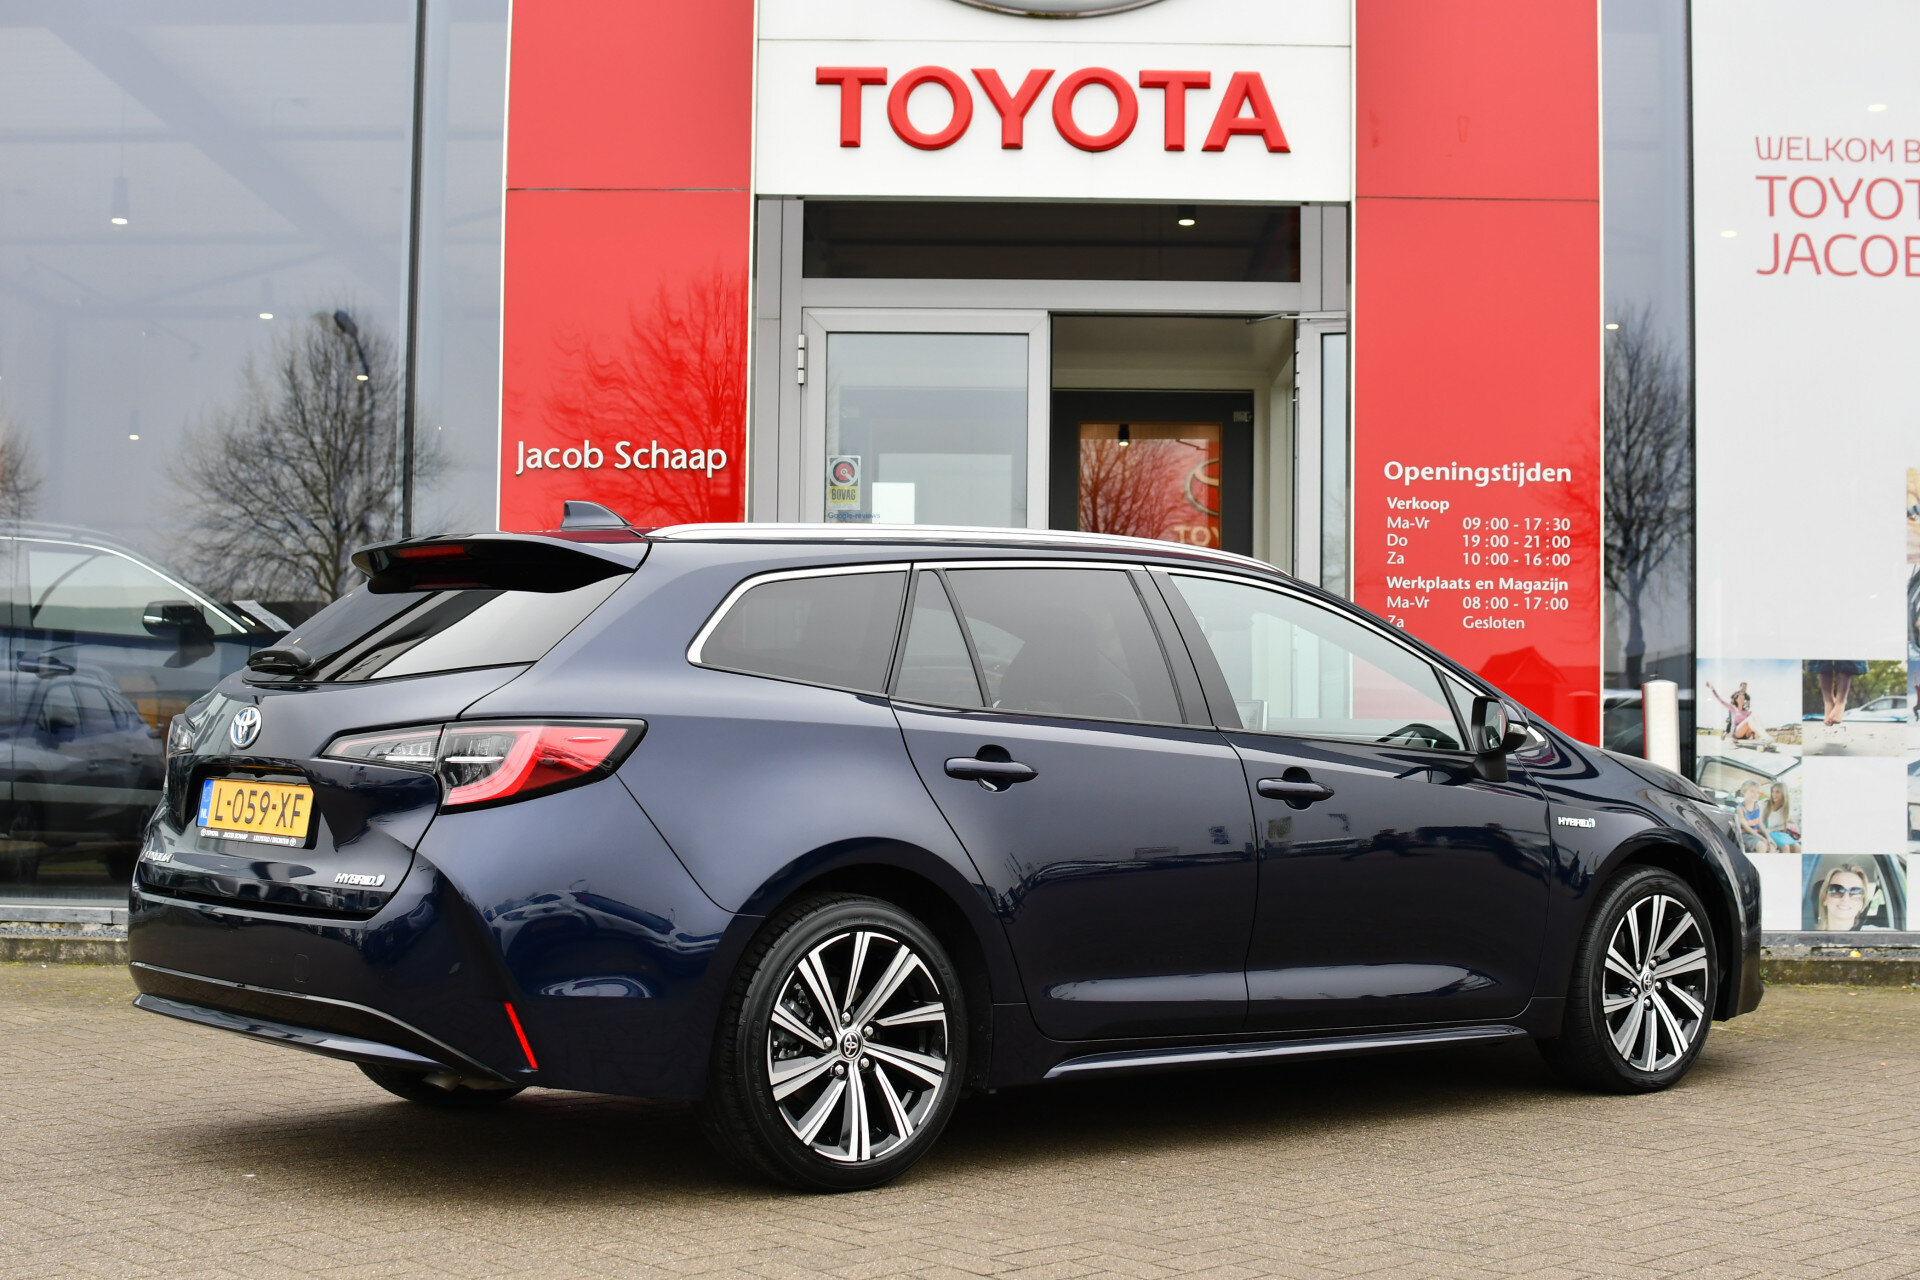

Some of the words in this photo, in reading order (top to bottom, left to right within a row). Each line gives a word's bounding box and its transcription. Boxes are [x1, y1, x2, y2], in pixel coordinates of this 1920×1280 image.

[815, 65, 1292, 154] TOYOTA
[1755, 136, 1894, 163] WELKOM
[515, 439, 604, 476] Jacob
[614, 439, 727, 479] Schaap
[1383, 460, 1572, 488] Openingstijden
[831, 488, 856, 501] BOVAG
[1386, 496, 1450, 514] Verkoop
[1386, 516, 1430, 529] Ma-Vr
[1387, 533, 1408, 547] Do
[1386, 551, 1405, 565] Za
[1386, 575, 1471, 592] Werkplaats
[1475, 579, 1494, 590] en
[1499, 577, 1569, 595] Magazijn
[1386, 595, 1430, 609] Ma-Vr
[1462, 615, 1526, 630] Gesloten
[199, 809, 208, 818] NL
[214, 787, 304, 829] L-059-XF
[334, 873, 377, 886] HYBRID
